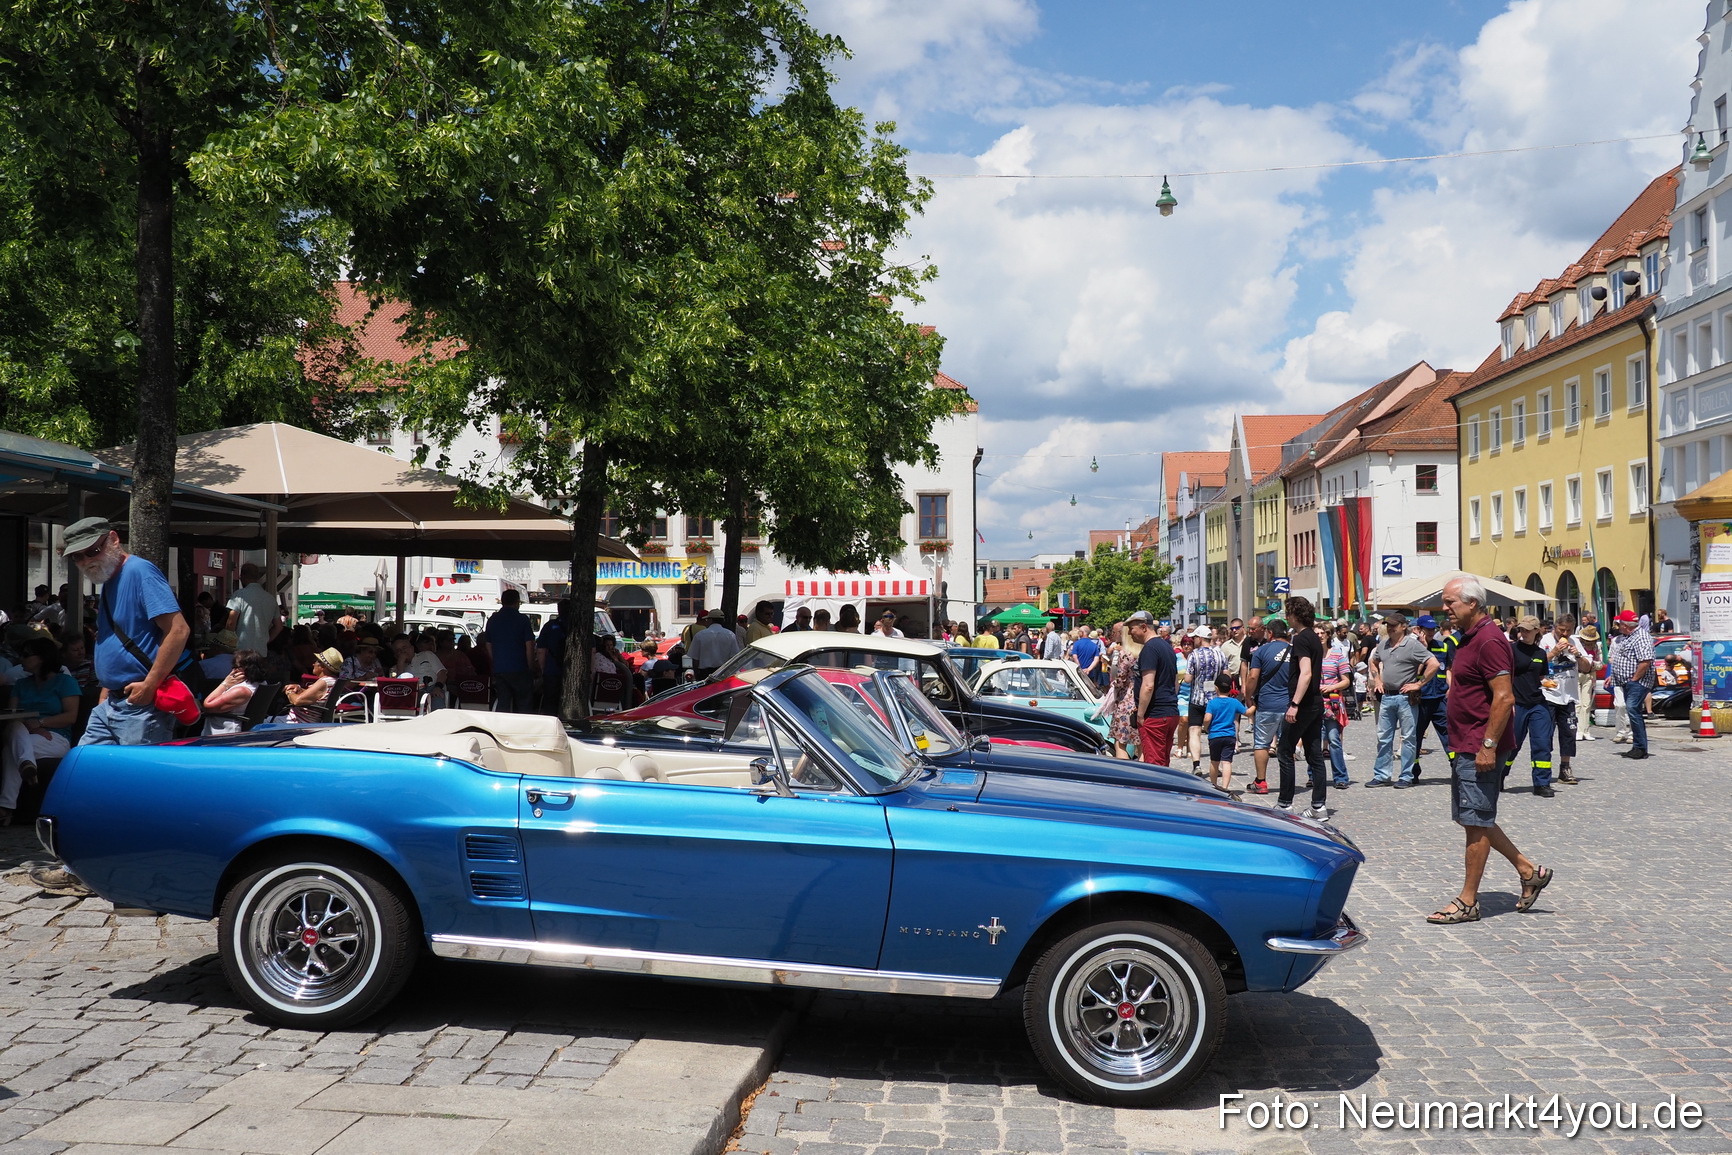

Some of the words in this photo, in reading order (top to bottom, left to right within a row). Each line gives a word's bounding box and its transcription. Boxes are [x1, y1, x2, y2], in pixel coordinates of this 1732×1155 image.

[455, 559, 480, 574] WC
[596, 561, 682, 579] NMELDUNG
[1706, 595, 1730, 605] VON
[899, 926, 980, 939] MUSTANG
